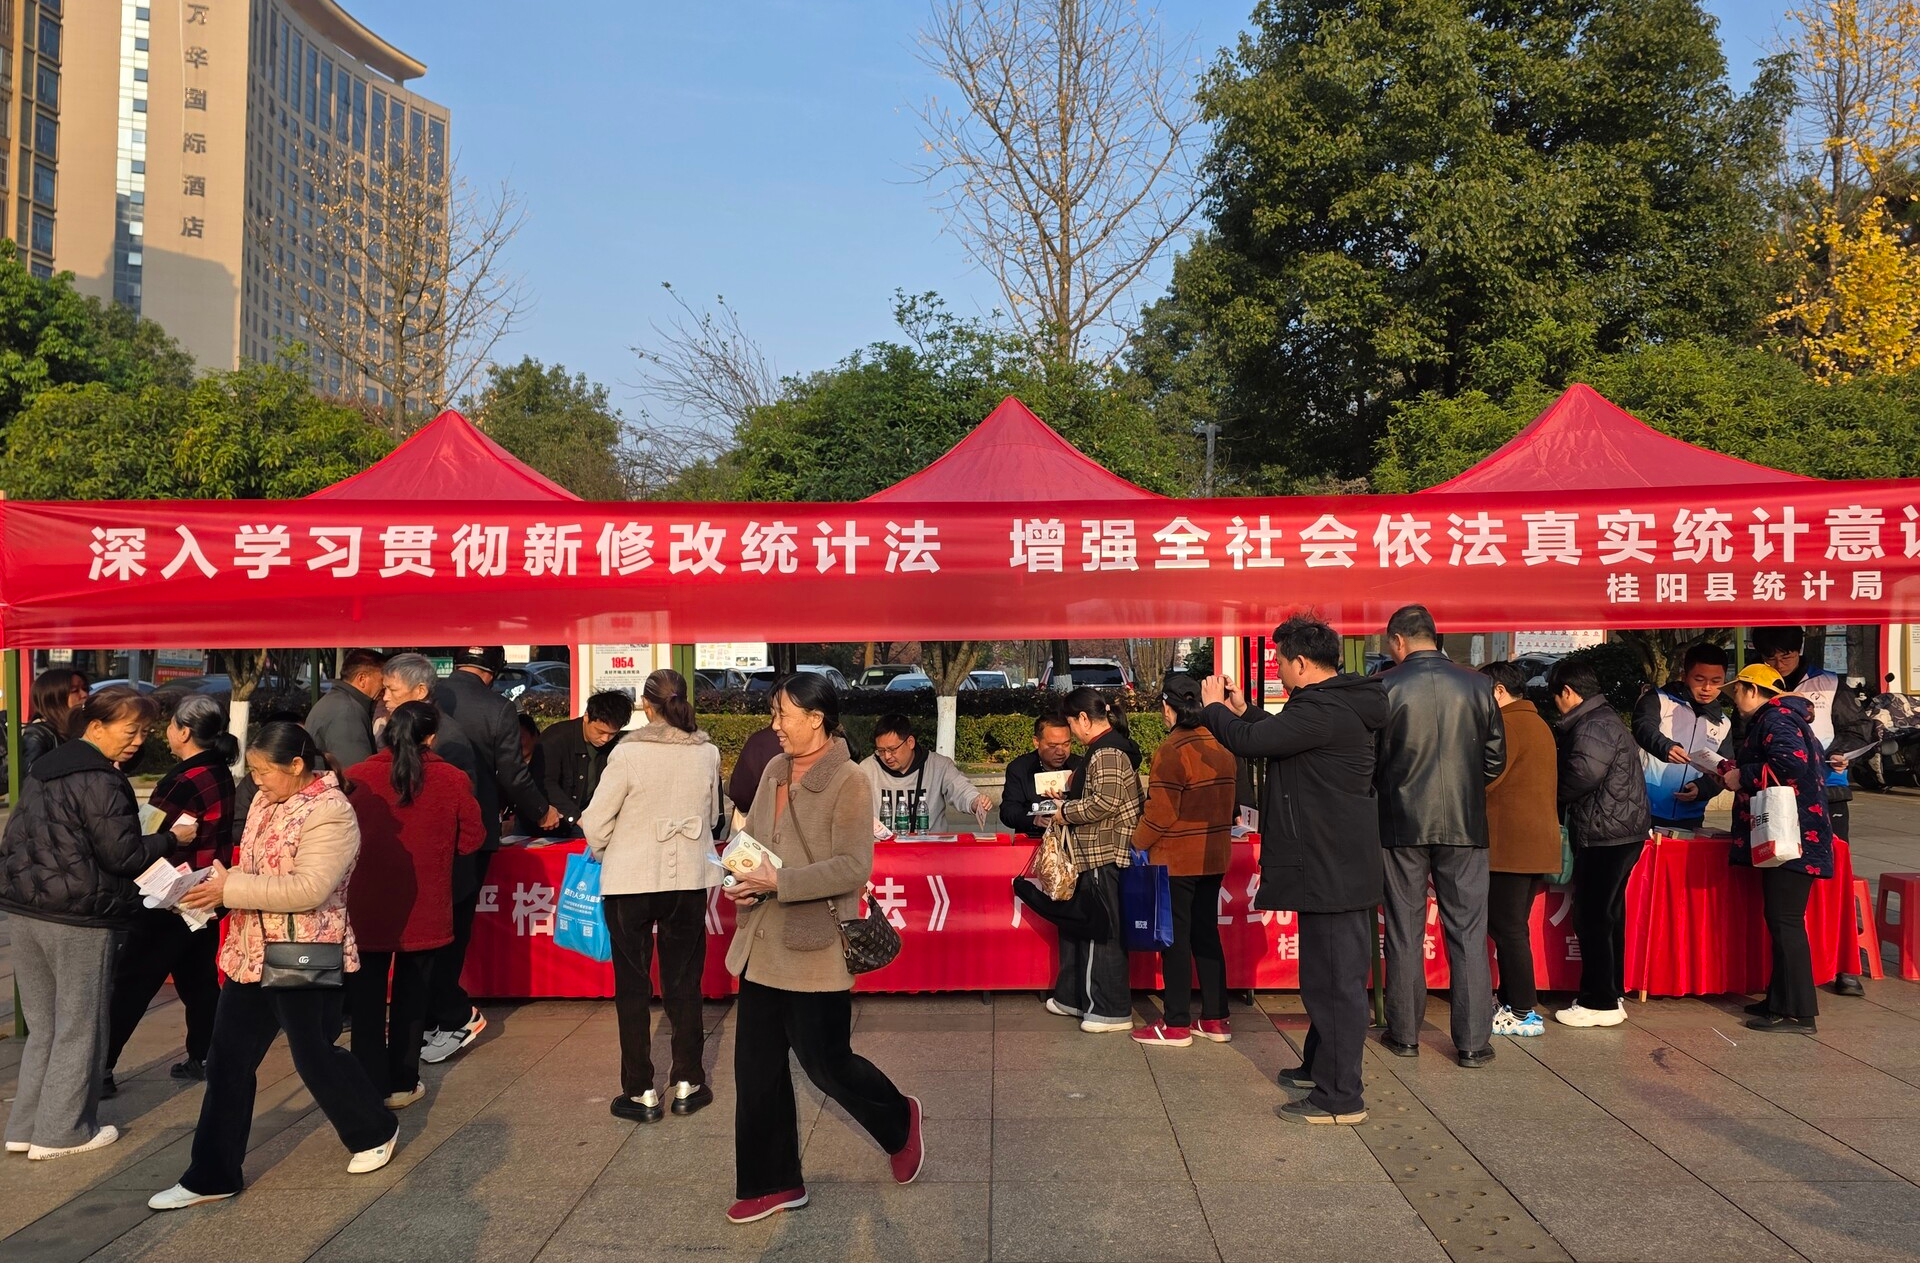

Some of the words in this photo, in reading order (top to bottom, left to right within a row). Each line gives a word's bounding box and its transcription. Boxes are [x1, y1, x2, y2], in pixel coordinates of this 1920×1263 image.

[181, 3, 210, 239] 万华国际酒店
[88, 520, 941, 581] 深入学习贯彻新修改统计法
[1606, 571, 1883, 604] 桂阳县统计局
[611, 656, 635, 668] 1954
